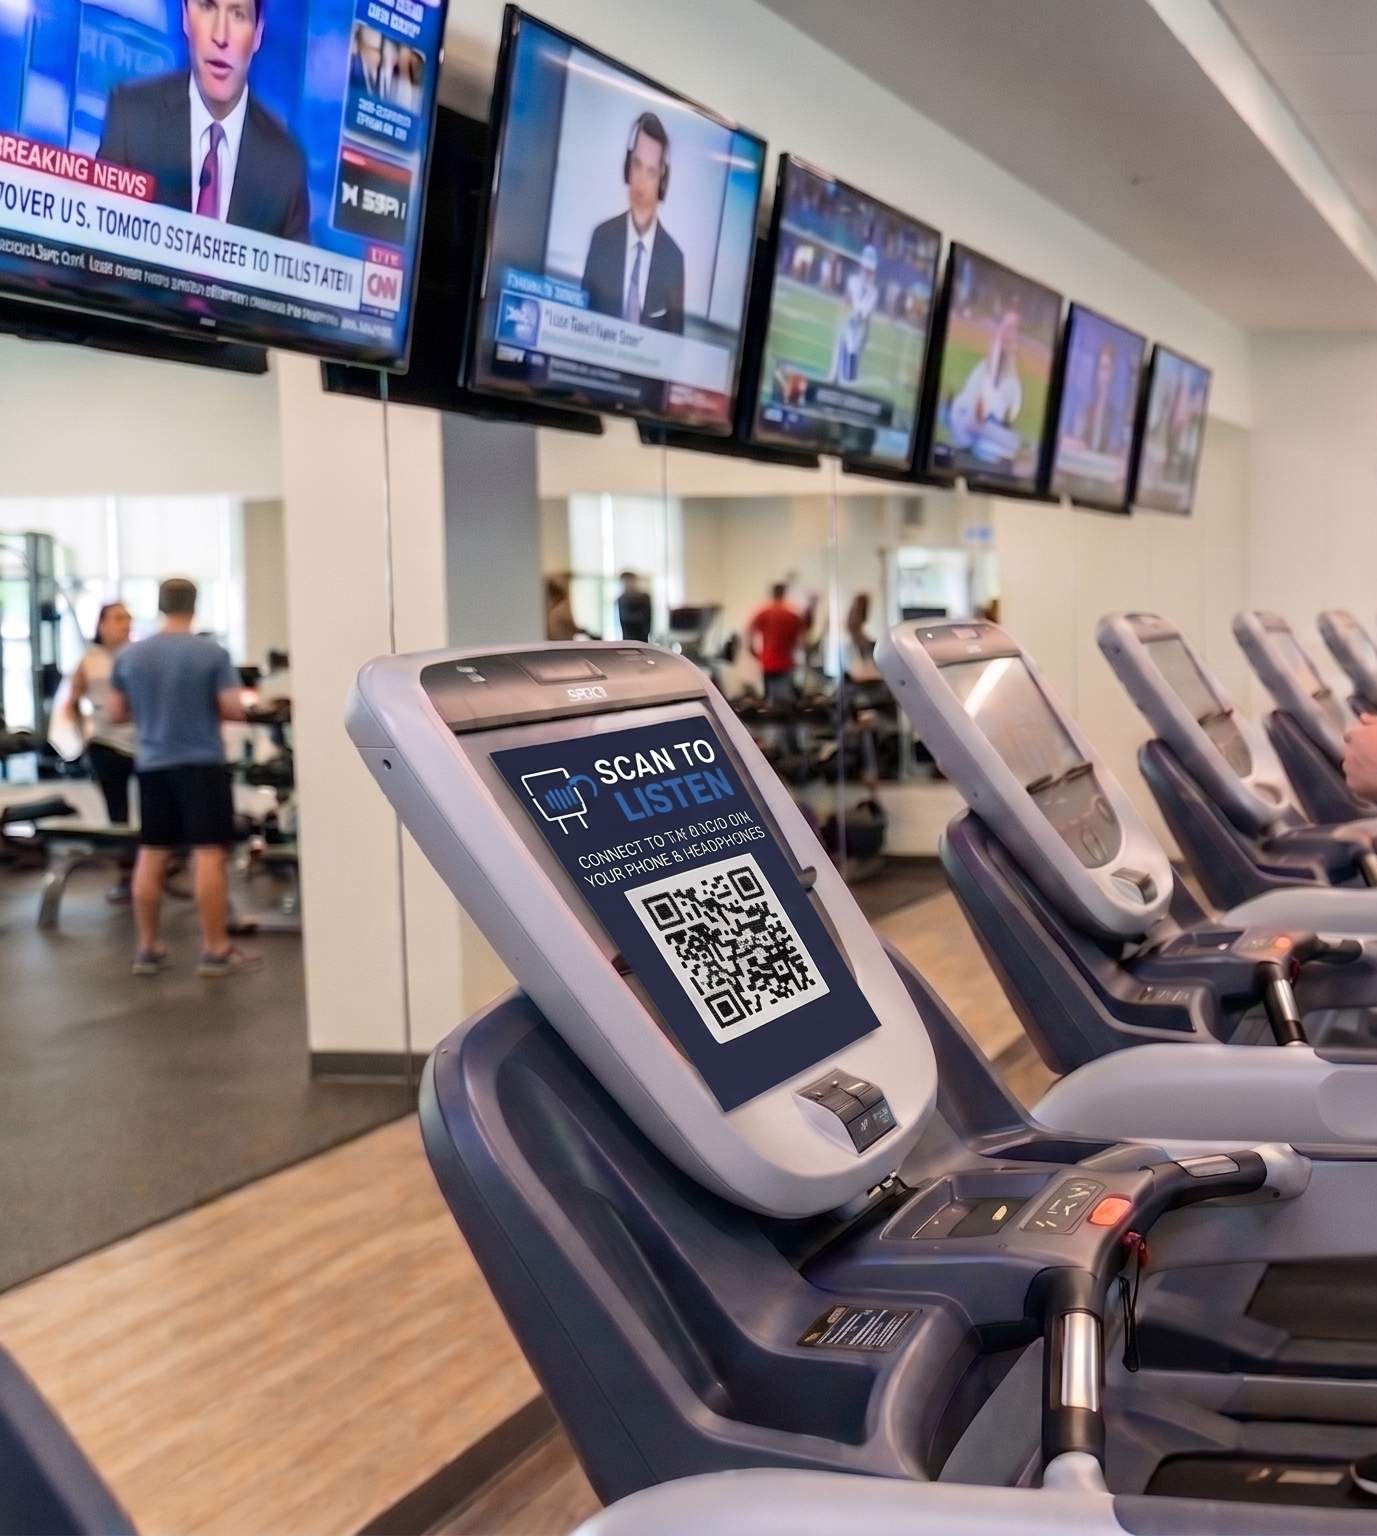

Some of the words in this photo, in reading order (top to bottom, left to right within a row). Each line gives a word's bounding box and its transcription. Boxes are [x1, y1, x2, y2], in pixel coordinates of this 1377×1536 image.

[0, 135, 89, 181] REAKING
[93, 162, 147, 198] NEWS
[96, 205, 162, 246] TOMOTO
[252, 247, 270, 272] TO
[367, 273, 398, 301] CNN
[594, 747, 677, 785] SCAN
[673, 739, 716, 767] TO
[613, 766, 735, 822] LISTEN
[578, 840, 644, 870] CONNECT
[644, 835, 666, 850] TO
[583, 865, 627, 888] YOUR
[624, 852, 673, 878] PHONE
[682, 825, 766, 860] HEADPHONES
